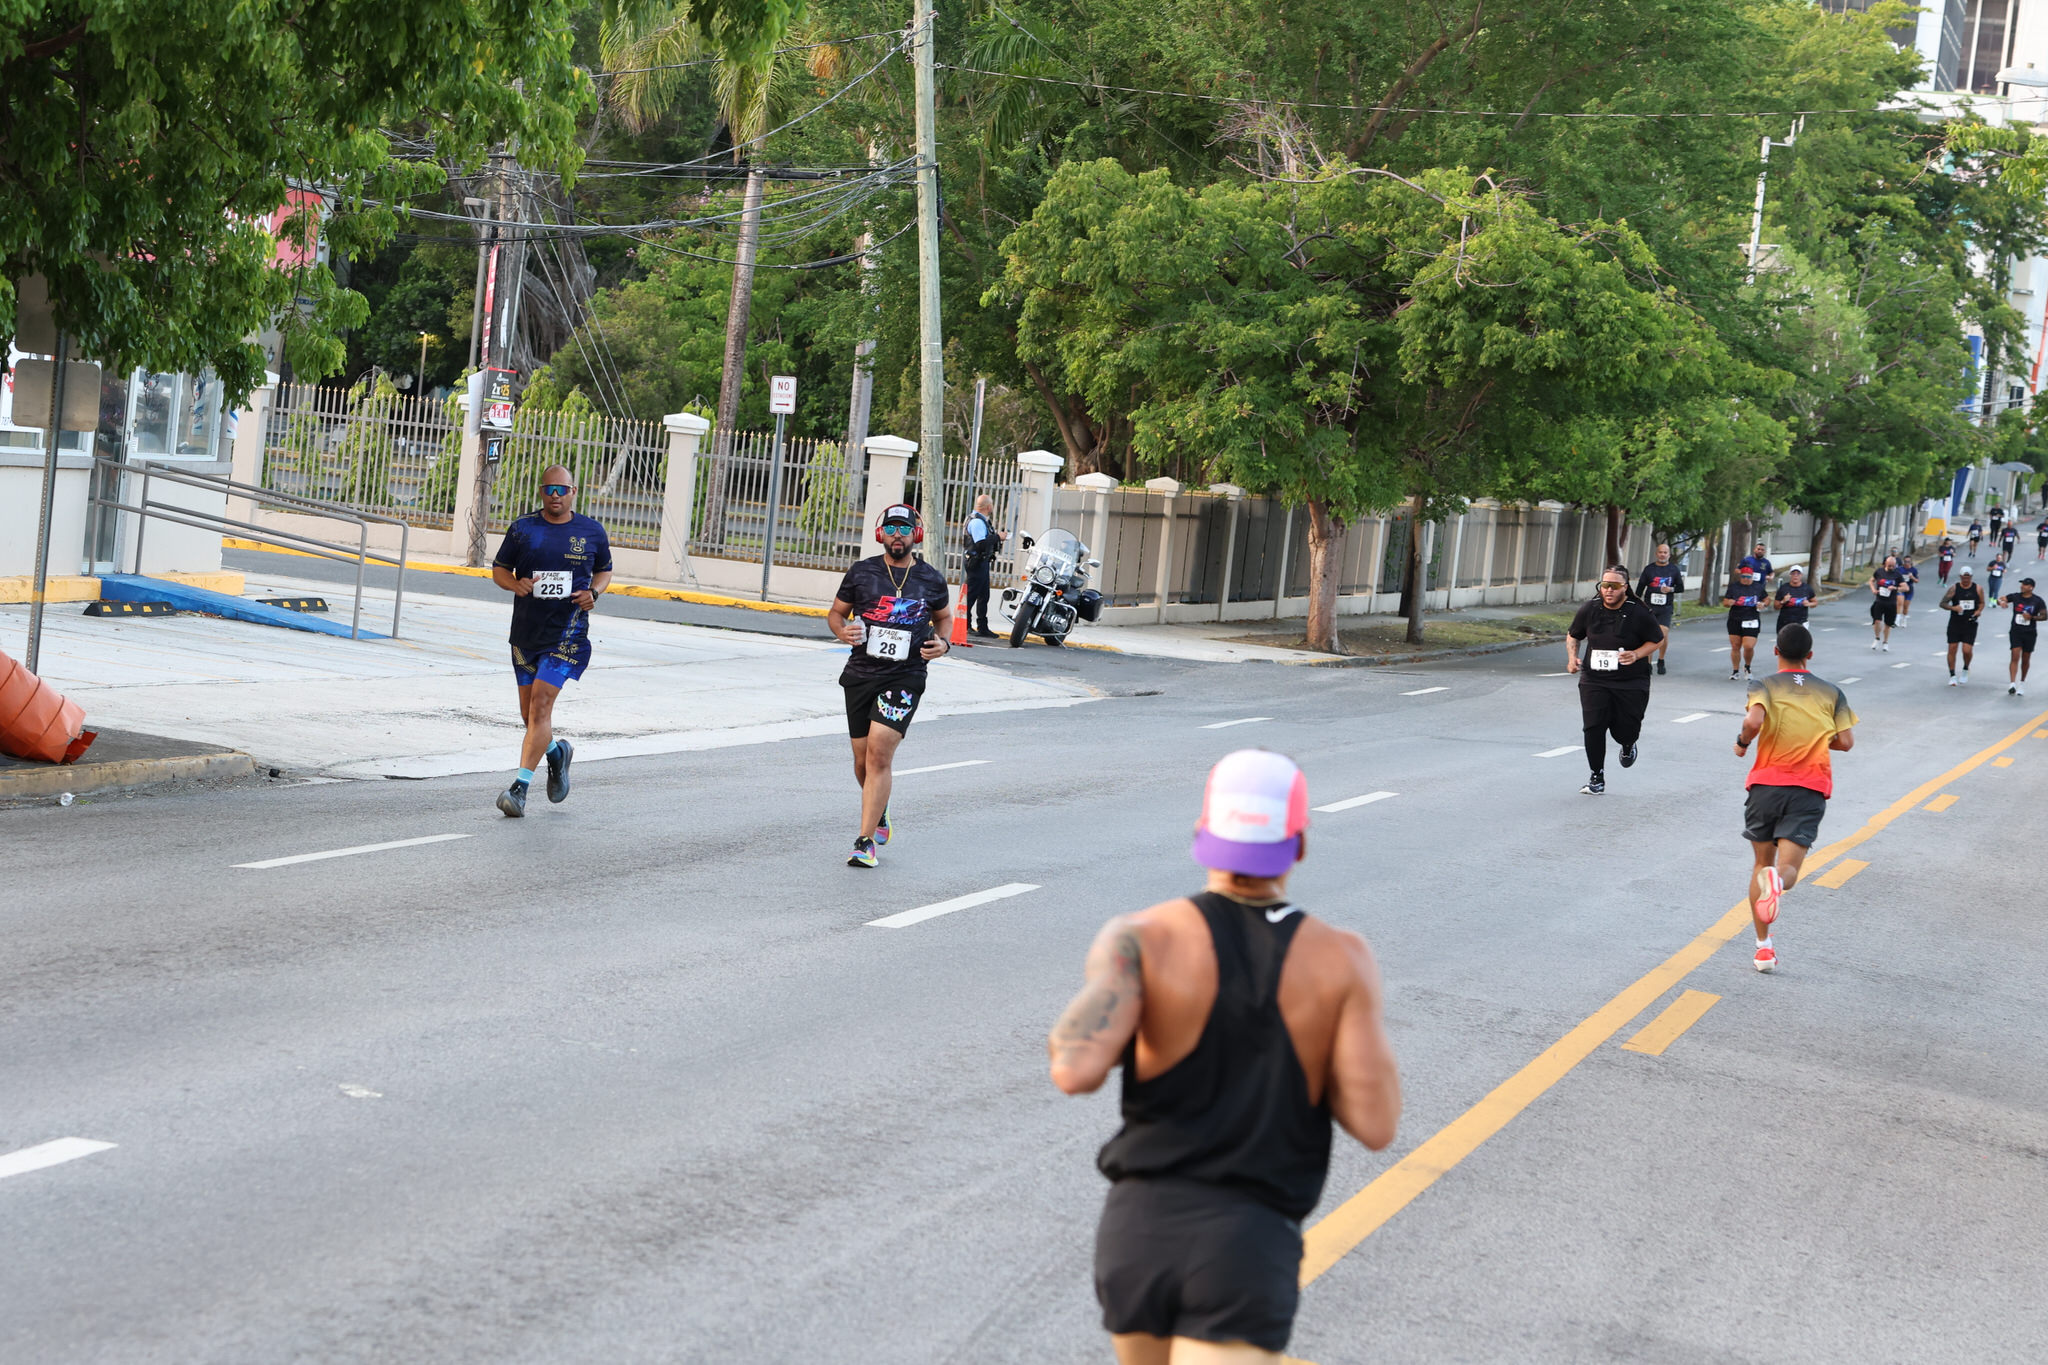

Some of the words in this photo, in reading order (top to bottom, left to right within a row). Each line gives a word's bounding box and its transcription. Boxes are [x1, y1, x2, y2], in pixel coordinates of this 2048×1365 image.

[778, 382, 790, 391] NO
[490, 409, 509, 418] RENT
[541, 583, 564, 595] 225
[874, 595, 918, 616] 5K
[879, 641, 897, 656] 28
[1598, 659, 1609, 668] 19
